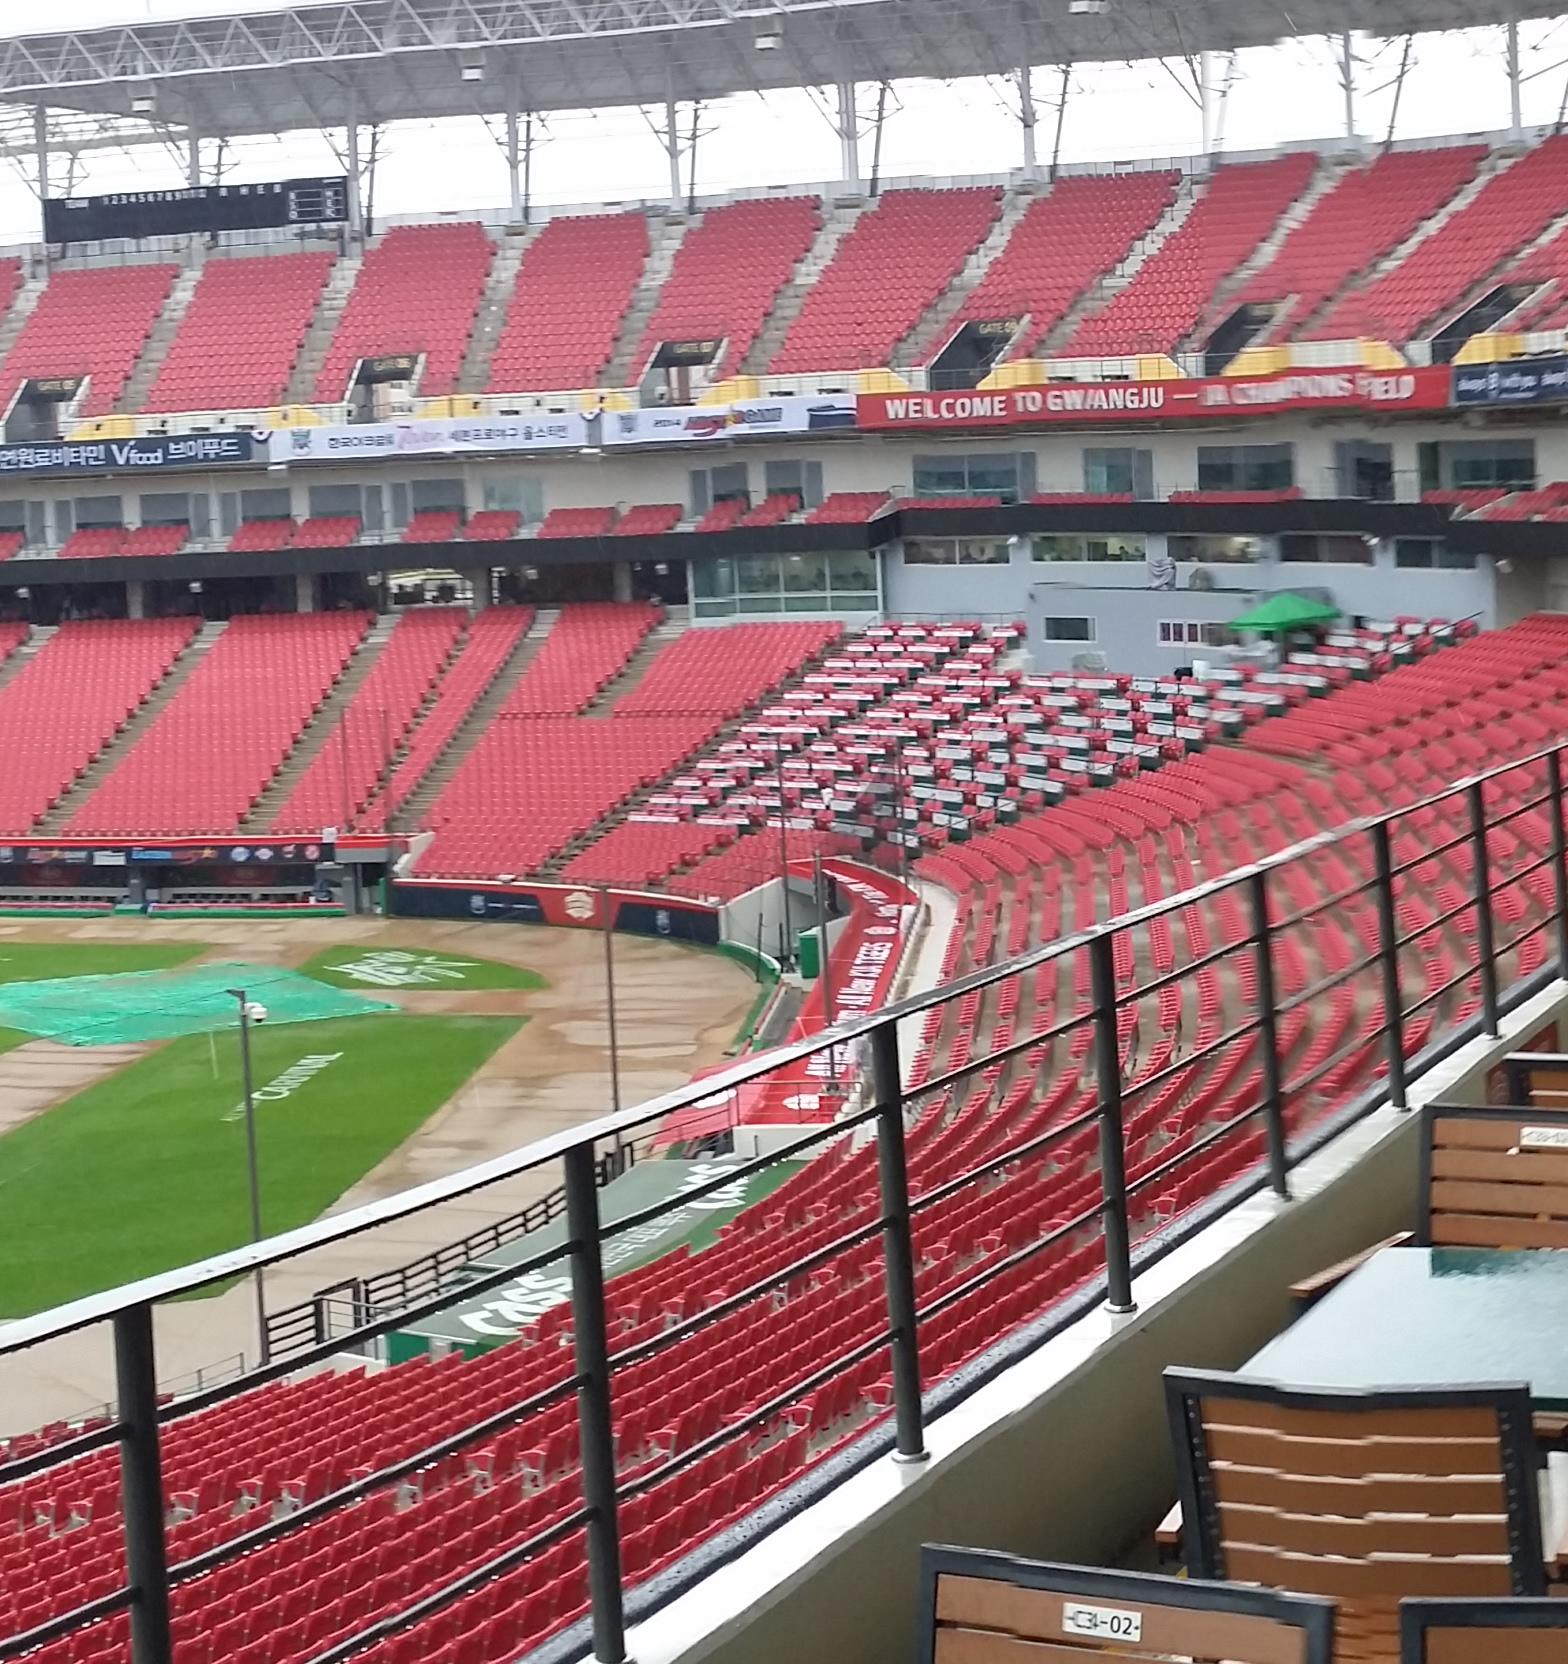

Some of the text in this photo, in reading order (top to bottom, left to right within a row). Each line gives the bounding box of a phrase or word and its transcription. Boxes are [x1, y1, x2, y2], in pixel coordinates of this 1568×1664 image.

[885, 396, 1007, 420] WELCOME
[1015, 391, 1043, 413] TO
[1046, 386, 1165, 412] GWANGJU
